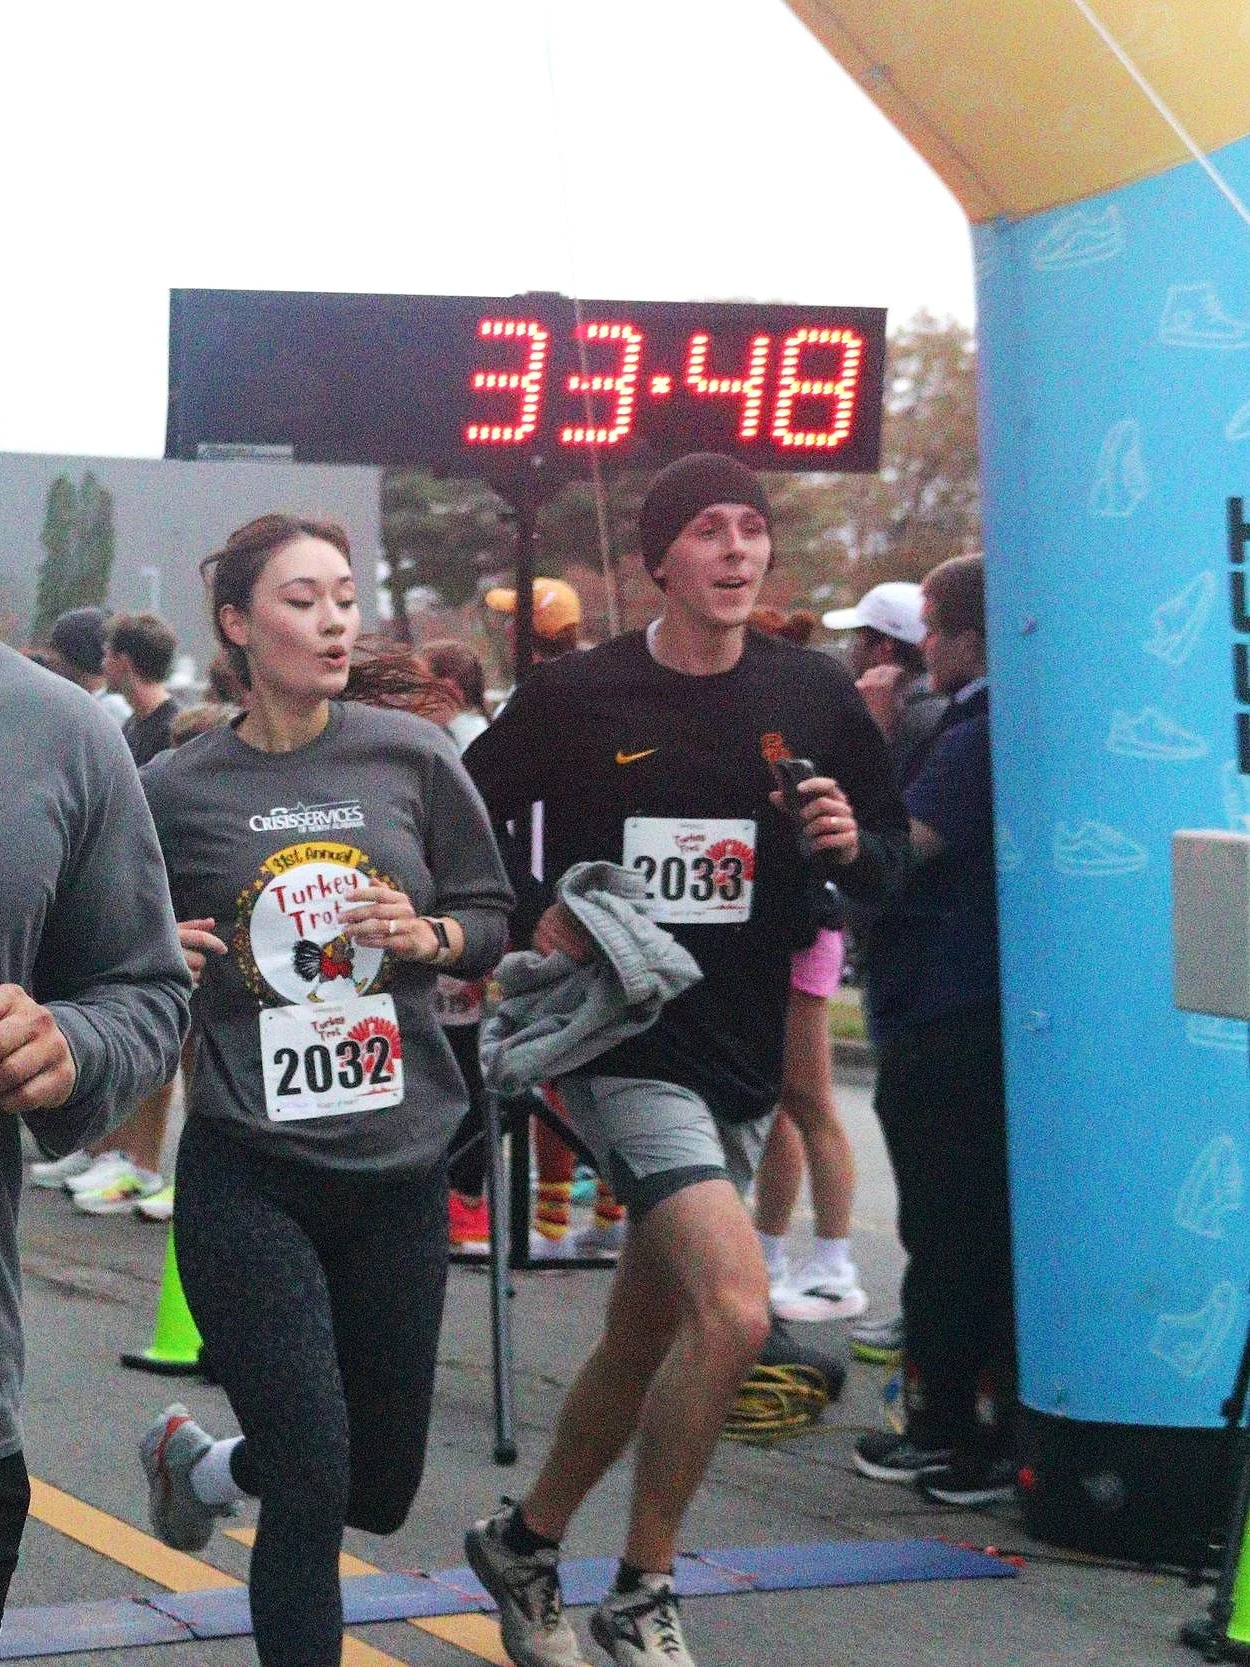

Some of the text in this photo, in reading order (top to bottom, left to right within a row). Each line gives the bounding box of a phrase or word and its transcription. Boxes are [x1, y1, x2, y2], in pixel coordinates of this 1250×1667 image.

[270, 873, 358, 913] Turkey
[632, 855, 743, 901] 2033
[273, 1036, 392, 1096] 2032
